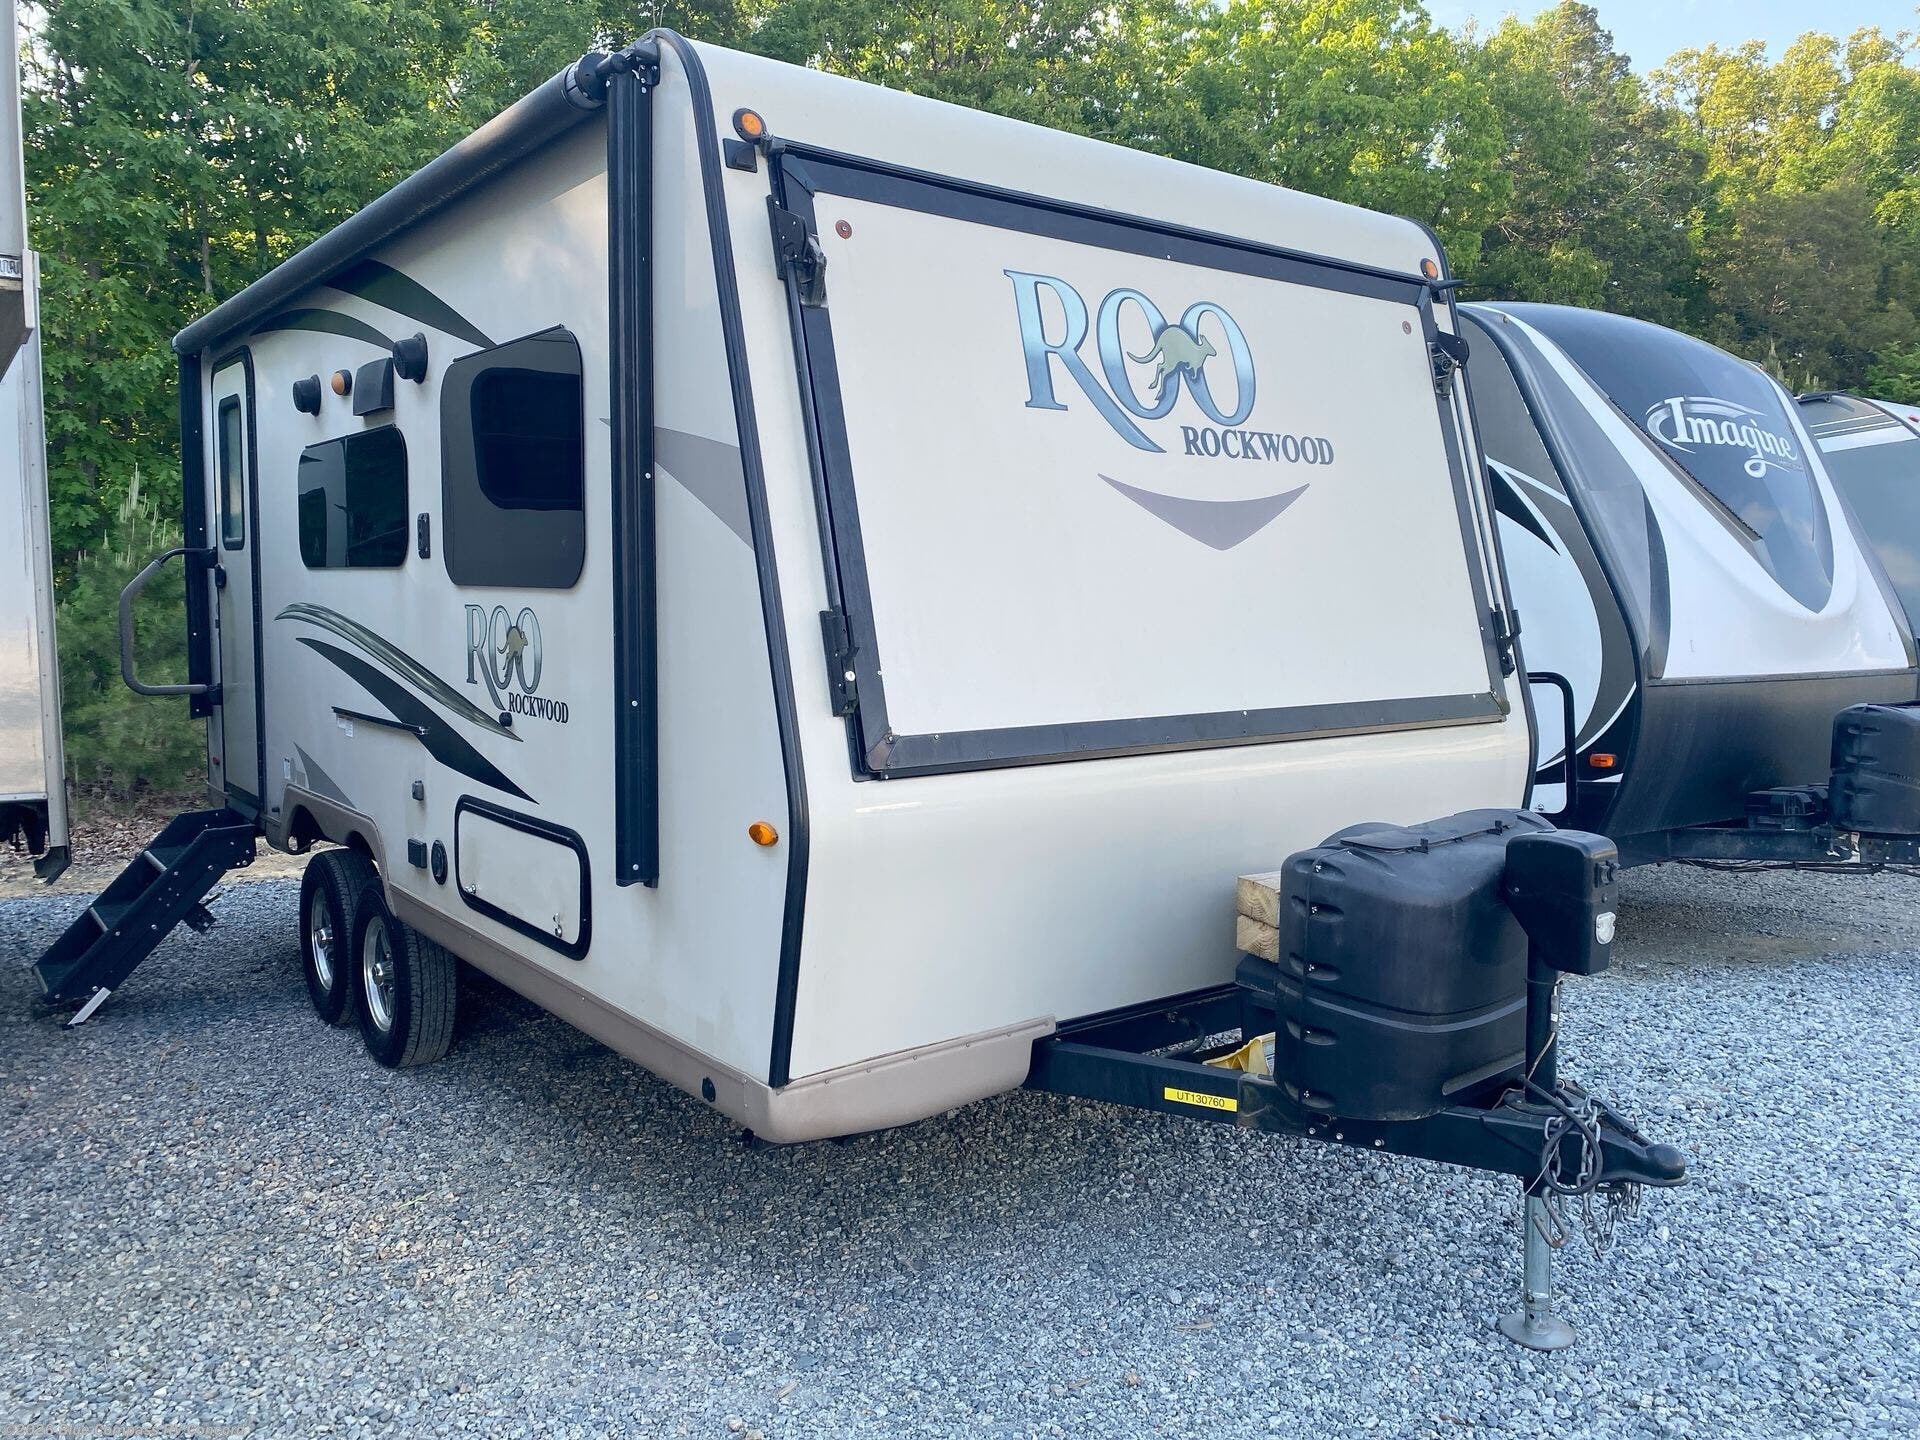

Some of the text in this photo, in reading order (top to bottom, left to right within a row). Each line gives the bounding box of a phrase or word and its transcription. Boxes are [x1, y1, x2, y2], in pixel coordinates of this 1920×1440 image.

[1003, 269, 1256, 453] ROO
[1180, 425, 1334, 465] ROCKWOOD
[1664, 397, 1798, 478] Imagine
[464, 604, 543, 711] ROO
[508, 692, 569, 723] ROCKWOOD
[1176, 1090, 1225, 1108] UT130760
